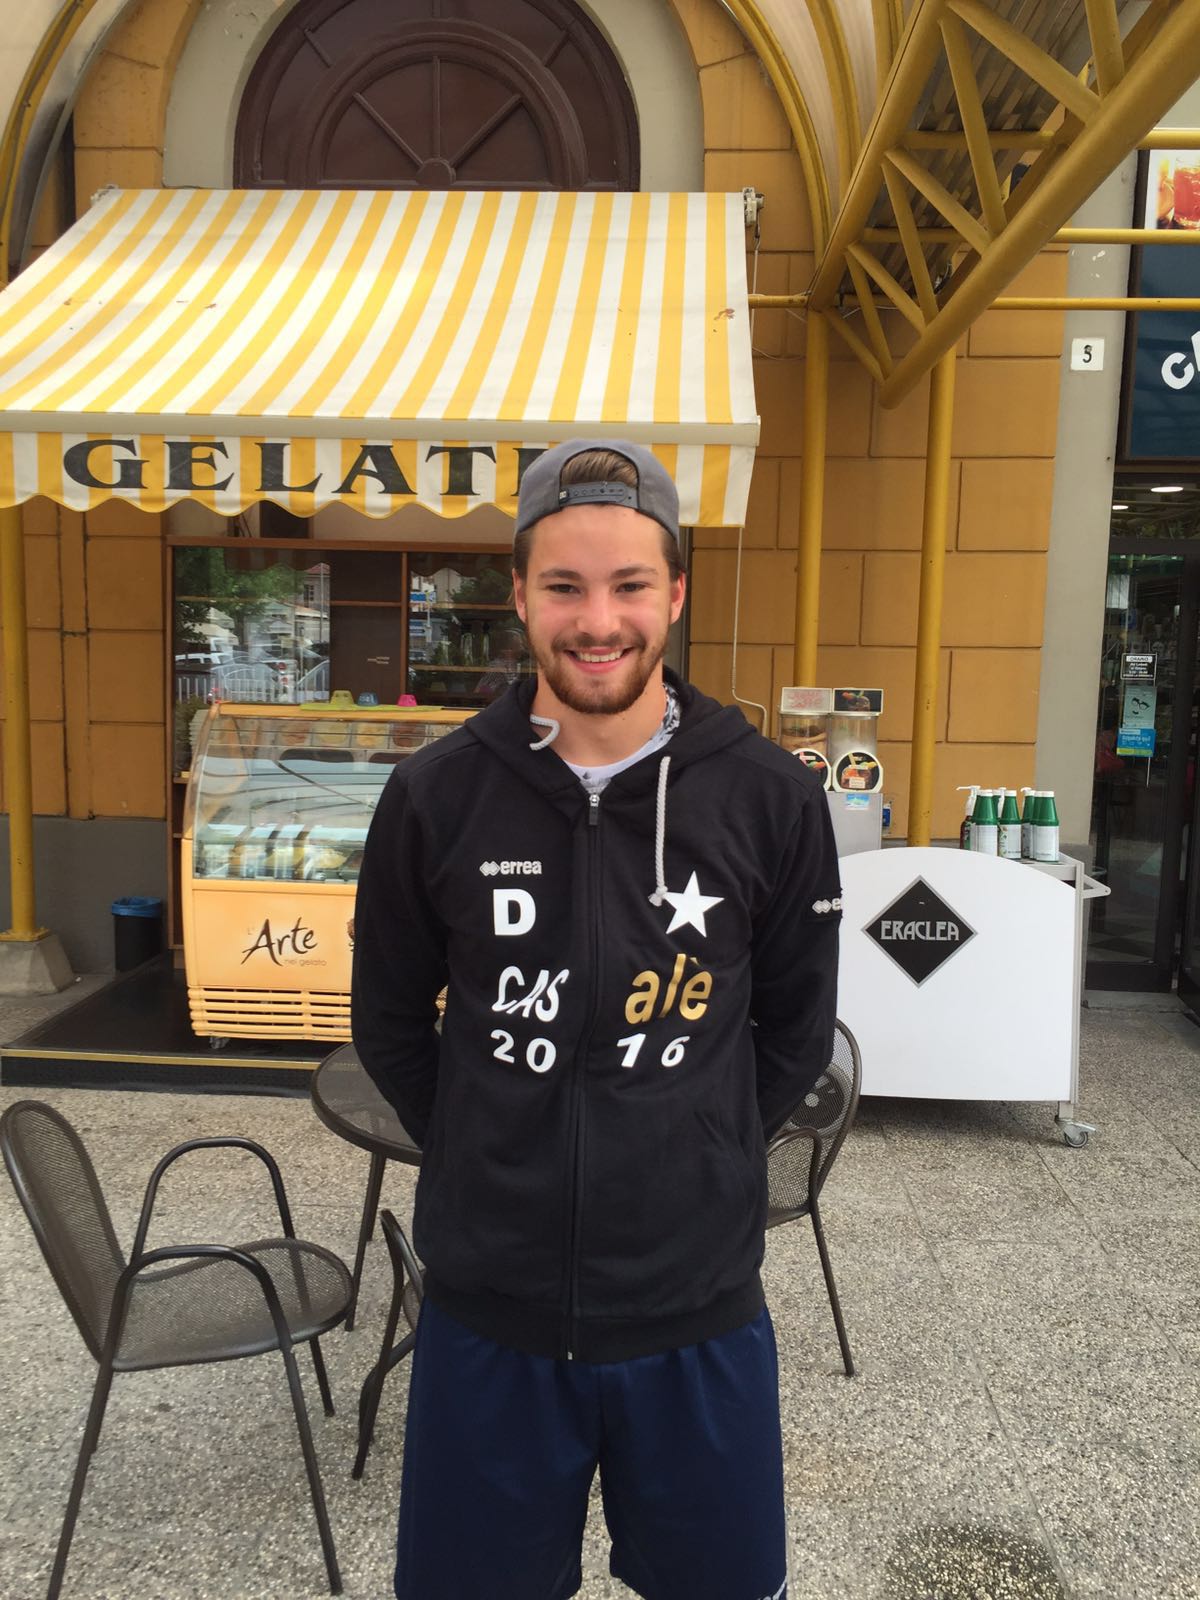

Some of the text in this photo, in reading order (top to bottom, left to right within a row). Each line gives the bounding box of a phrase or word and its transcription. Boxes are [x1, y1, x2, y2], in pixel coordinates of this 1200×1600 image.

[500, 860, 542, 876] errea
[493, 889, 536, 936] D
[880, 920, 960, 941] ERACLEA
